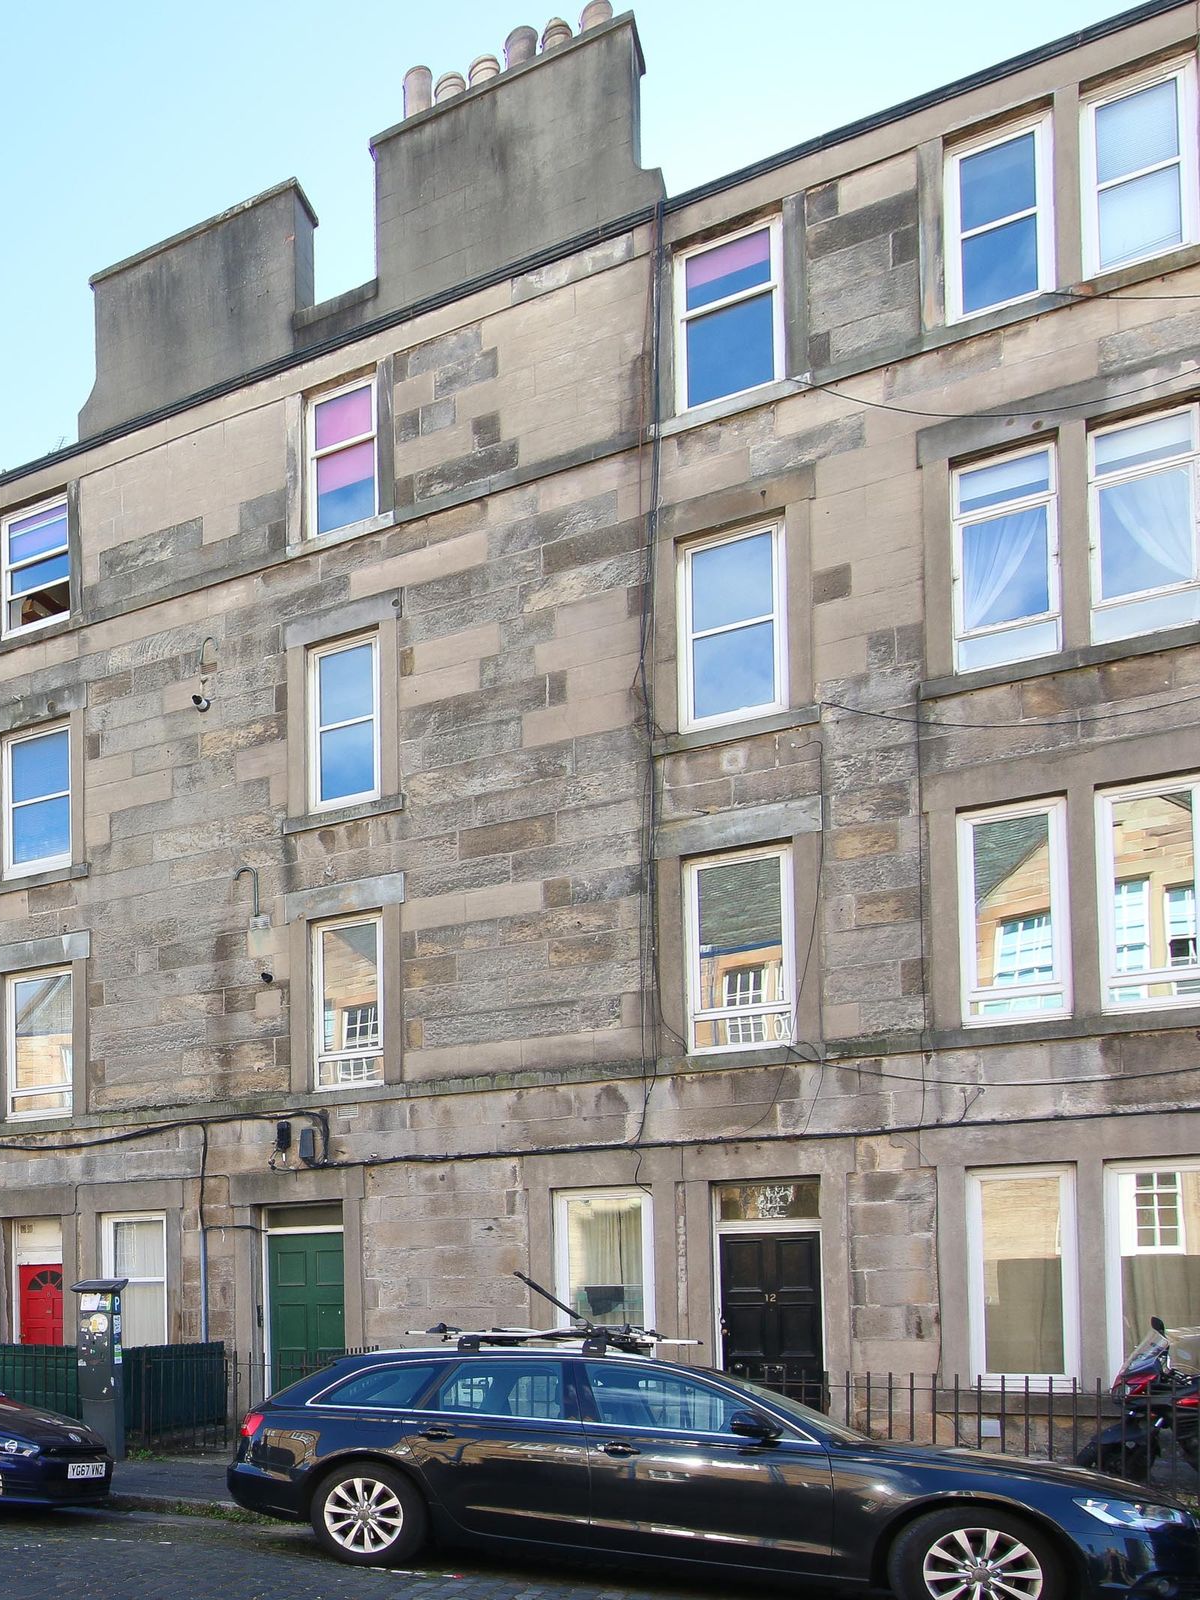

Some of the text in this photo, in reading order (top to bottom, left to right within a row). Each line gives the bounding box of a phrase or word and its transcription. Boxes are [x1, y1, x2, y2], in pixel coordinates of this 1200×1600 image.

[764, 1293, 777, 1302] 12
[115, 1296, 120, 1311] P
[71, 1465, 90, 1476] YG67
